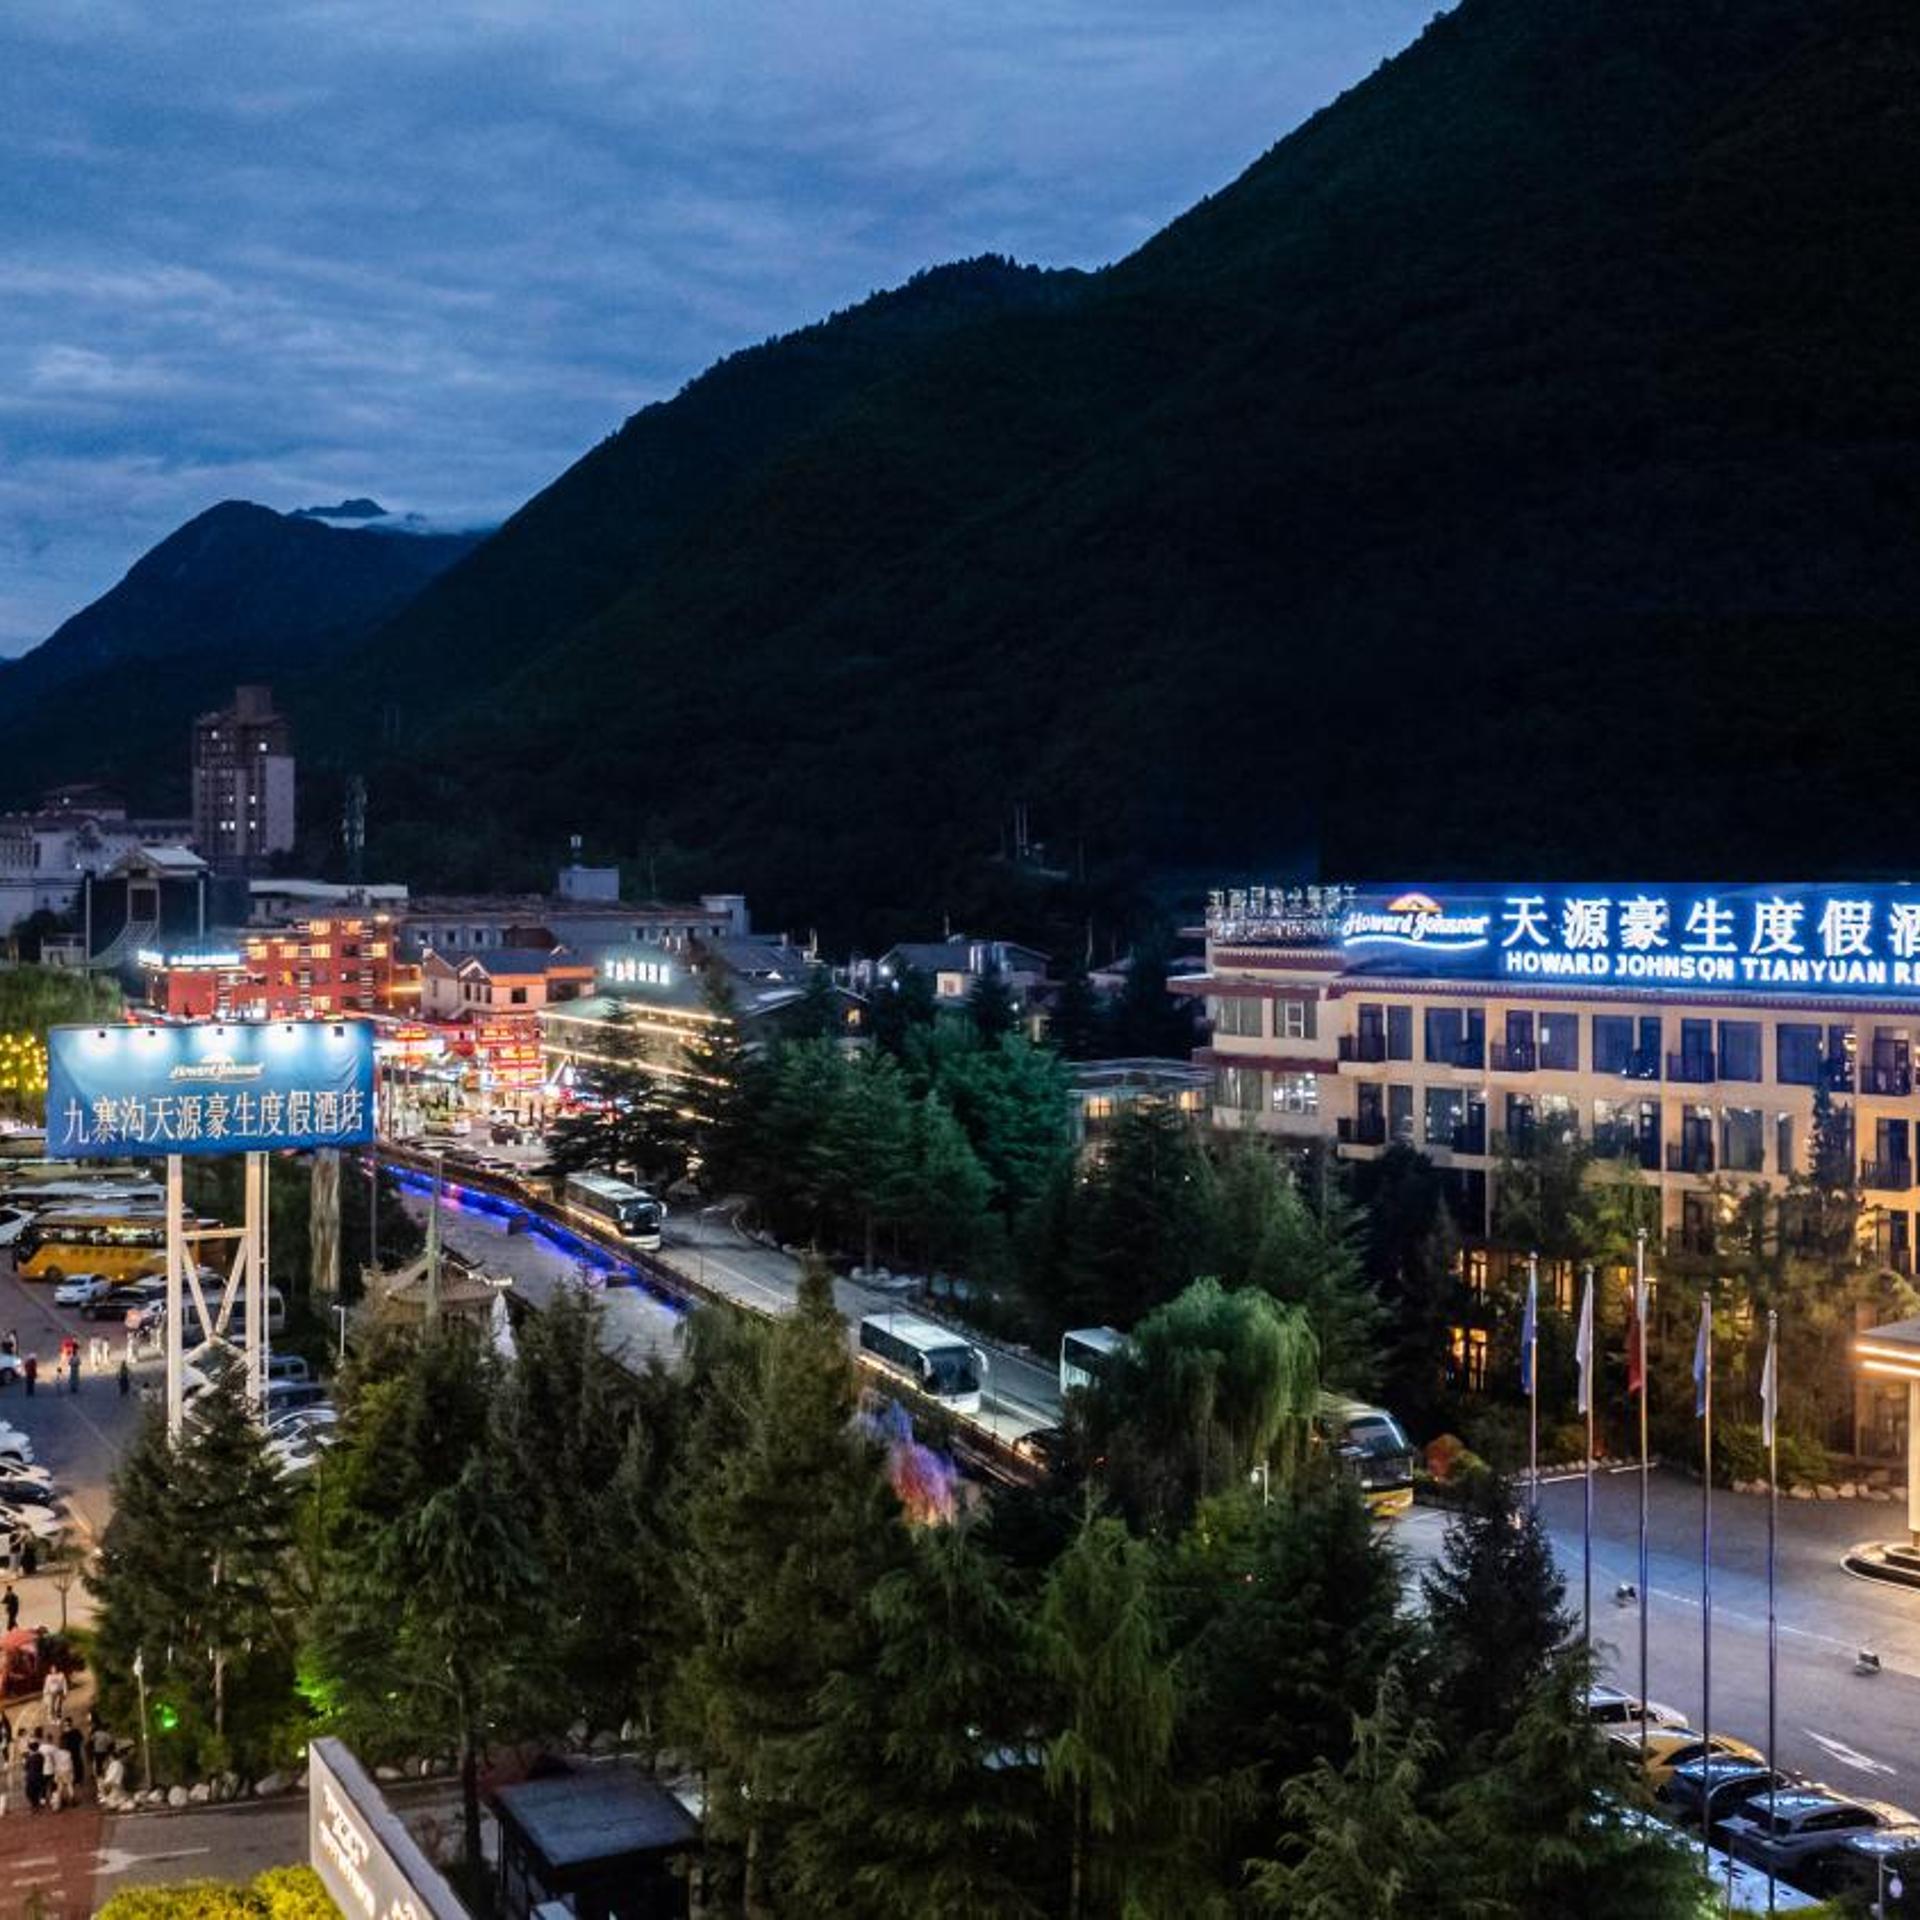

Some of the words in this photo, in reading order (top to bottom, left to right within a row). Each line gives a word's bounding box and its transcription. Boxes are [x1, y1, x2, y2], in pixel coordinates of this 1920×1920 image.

[1343, 912, 1413, 937] Howard
[1507, 951, 1609, 975] HOWARD
[1740, 956, 1887, 984] TIANYUAN
[63, 1088, 365, 1145] 九寨沟天源豪生度假酒店
